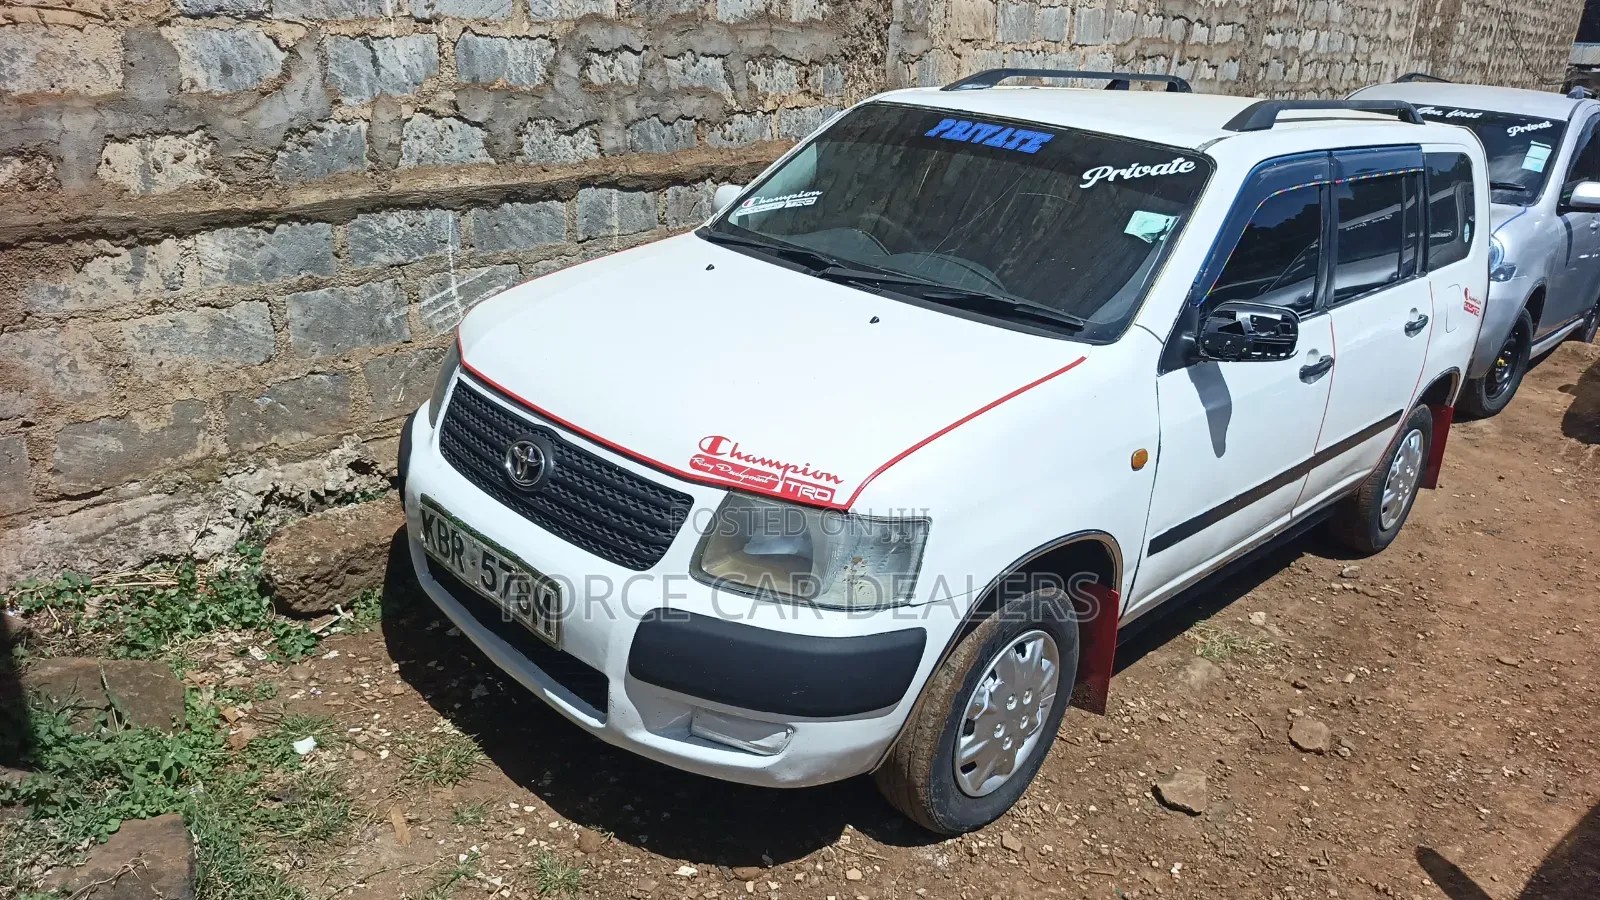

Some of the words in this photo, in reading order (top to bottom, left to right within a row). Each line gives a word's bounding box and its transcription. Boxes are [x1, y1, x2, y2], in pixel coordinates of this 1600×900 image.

[924, 118, 1055, 154] PRIVATE
[1079, 157, 1196, 189] Private
[742, 190, 823, 208] Champion
[698, 435, 845, 485] Champion
[785, 479, 832, 501] TRD
[421, 508, 465, 574] KBR
